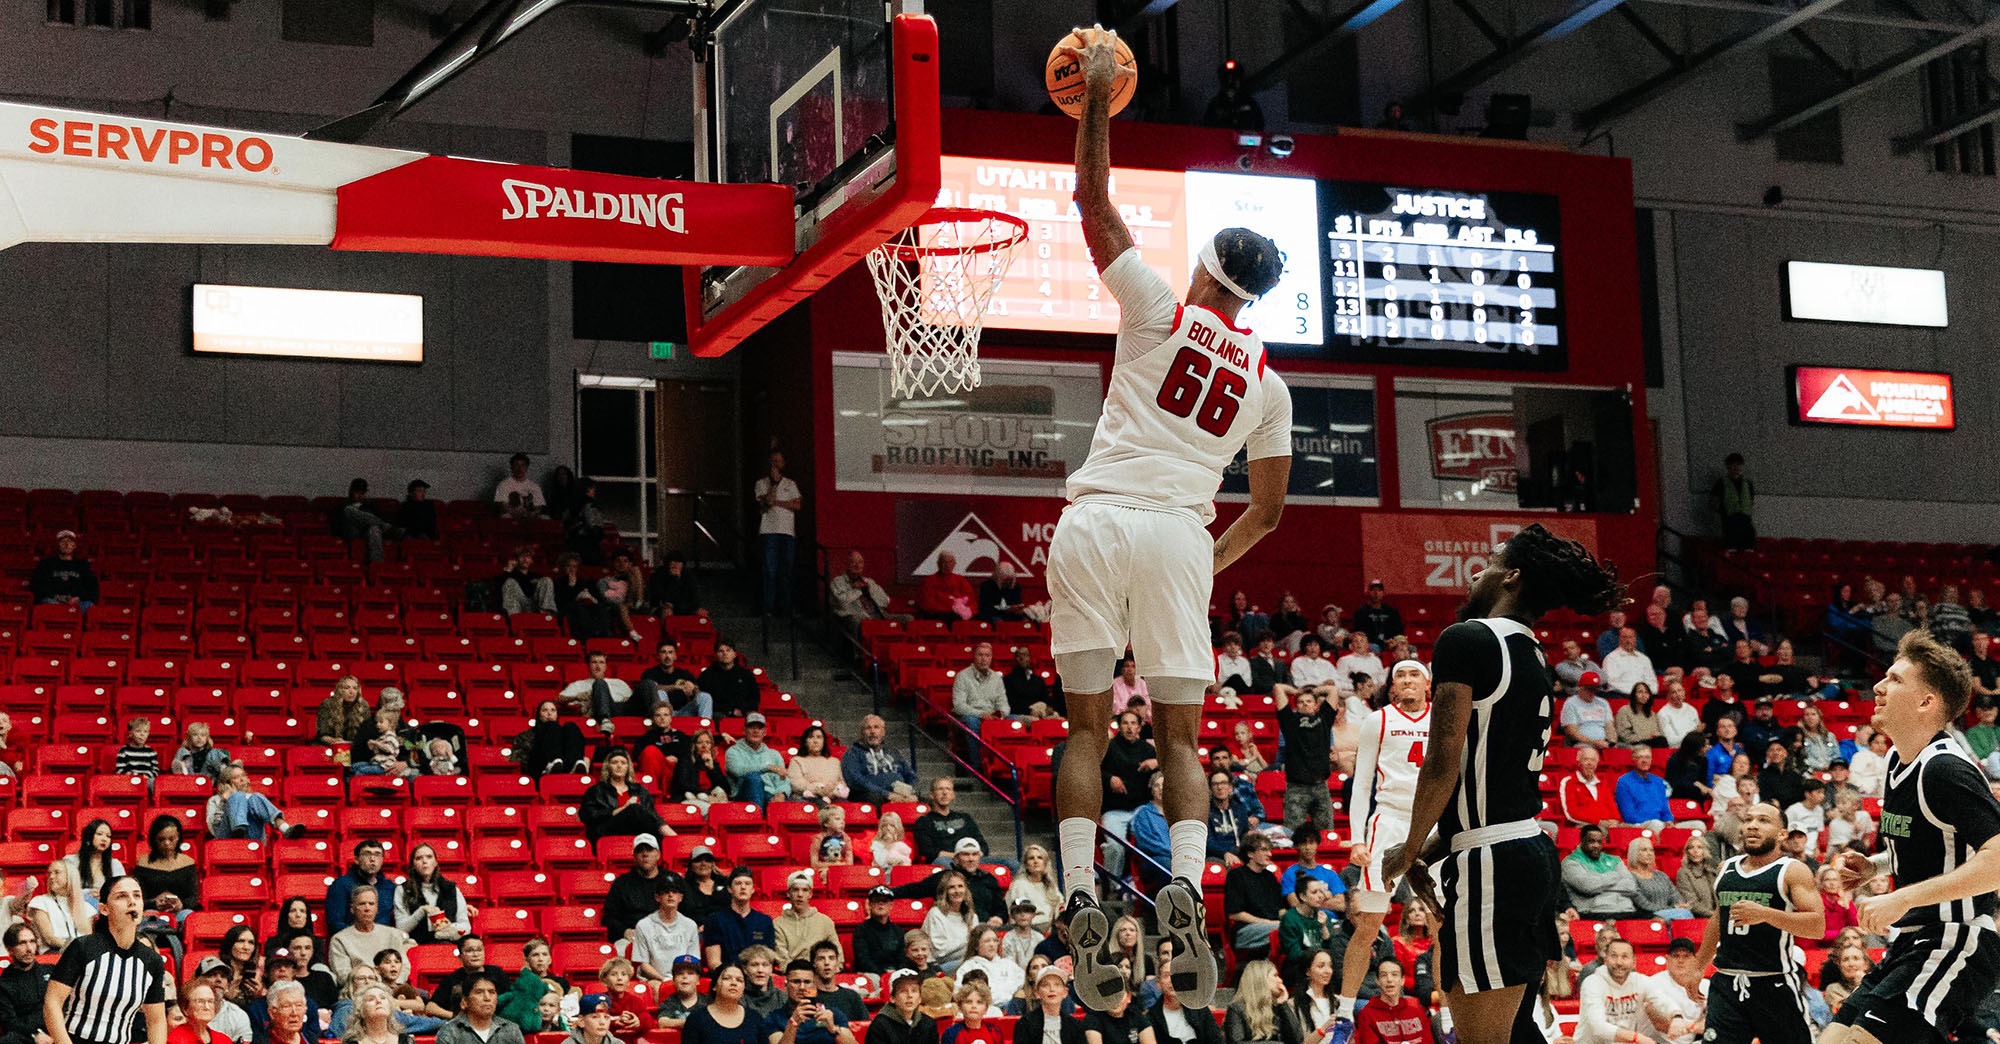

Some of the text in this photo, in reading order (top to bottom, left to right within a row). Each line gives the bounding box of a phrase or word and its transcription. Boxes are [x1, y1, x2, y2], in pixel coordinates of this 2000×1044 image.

[28, 118, 274, 173] SERVPRO
[976, 165, 1047, 189] UTAH
[501, 178, 686, 234] SPALDING
[1392, 194, 1486, 220] JUSTICE
[1040, 224, 1053, 240] 3
[1369, 219, 1404, 237] PTS
[1457, 226, 1495, 243] AST
[1038, 243, 1052, 259] 0
[1338, 243, 1529, 271] 3 2 1 0 1
[1039, 262, 1051, 279] 1
[1334, 261, 1530, 290] 11 0 1 0 0
[1087, 284, 1100, 300] 2
[1296, 292, 1310, 311] 8
[1335, 281, 1532, 310] 12 0 1 0 0
[1087, 303, 1099, 319] 1
[1336, 299, 1533, 327] 13 0 0 0 2
[1295, 316, 1308, 335] 3
[1337, 317, 1534, 345] 21 2 0 0 0
[1187, 320, 1251, 372] BOLANGA
[1156, 345, 1248, 438] 66
[882, 412, 1056, 450] STOUT
[886, 446, 995, 468] ROOFING
[1437, 429, 1516, 468] ERN
[1424, 541, 1489, 554] GREATER
[1424, 555, 1488, 588] ZIO
[1407, 741, 1426, 768] 4
